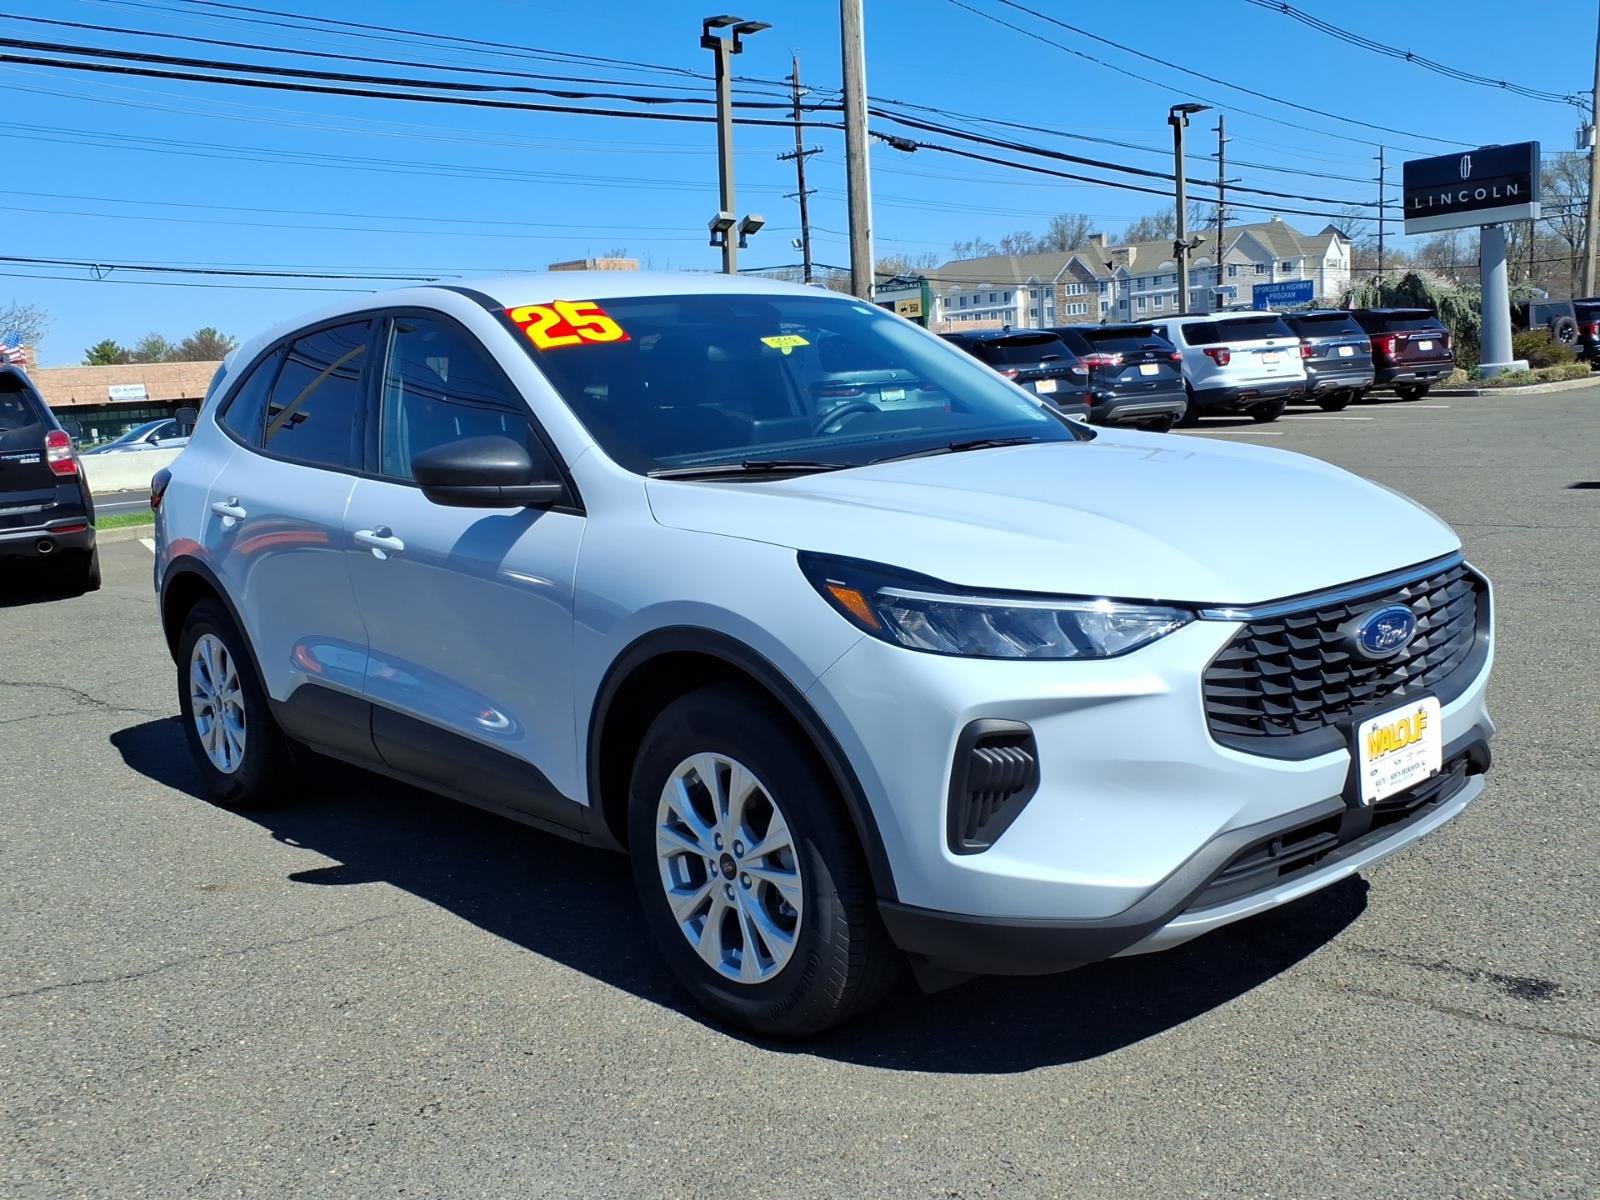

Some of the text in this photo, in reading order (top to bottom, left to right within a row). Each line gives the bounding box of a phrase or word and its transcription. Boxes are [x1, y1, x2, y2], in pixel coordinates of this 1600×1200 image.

[1415, 184, 1518, 208] LINCOLN
[1269, 292, 1296, 300] PROGRAM
[1286, 282, 1311, 290] HIGHWAY
[510, 300, 624, 349] 25
[1374, 620, 1408, 648] Ford
[1367, 711, 1428, 762] MALOUF
